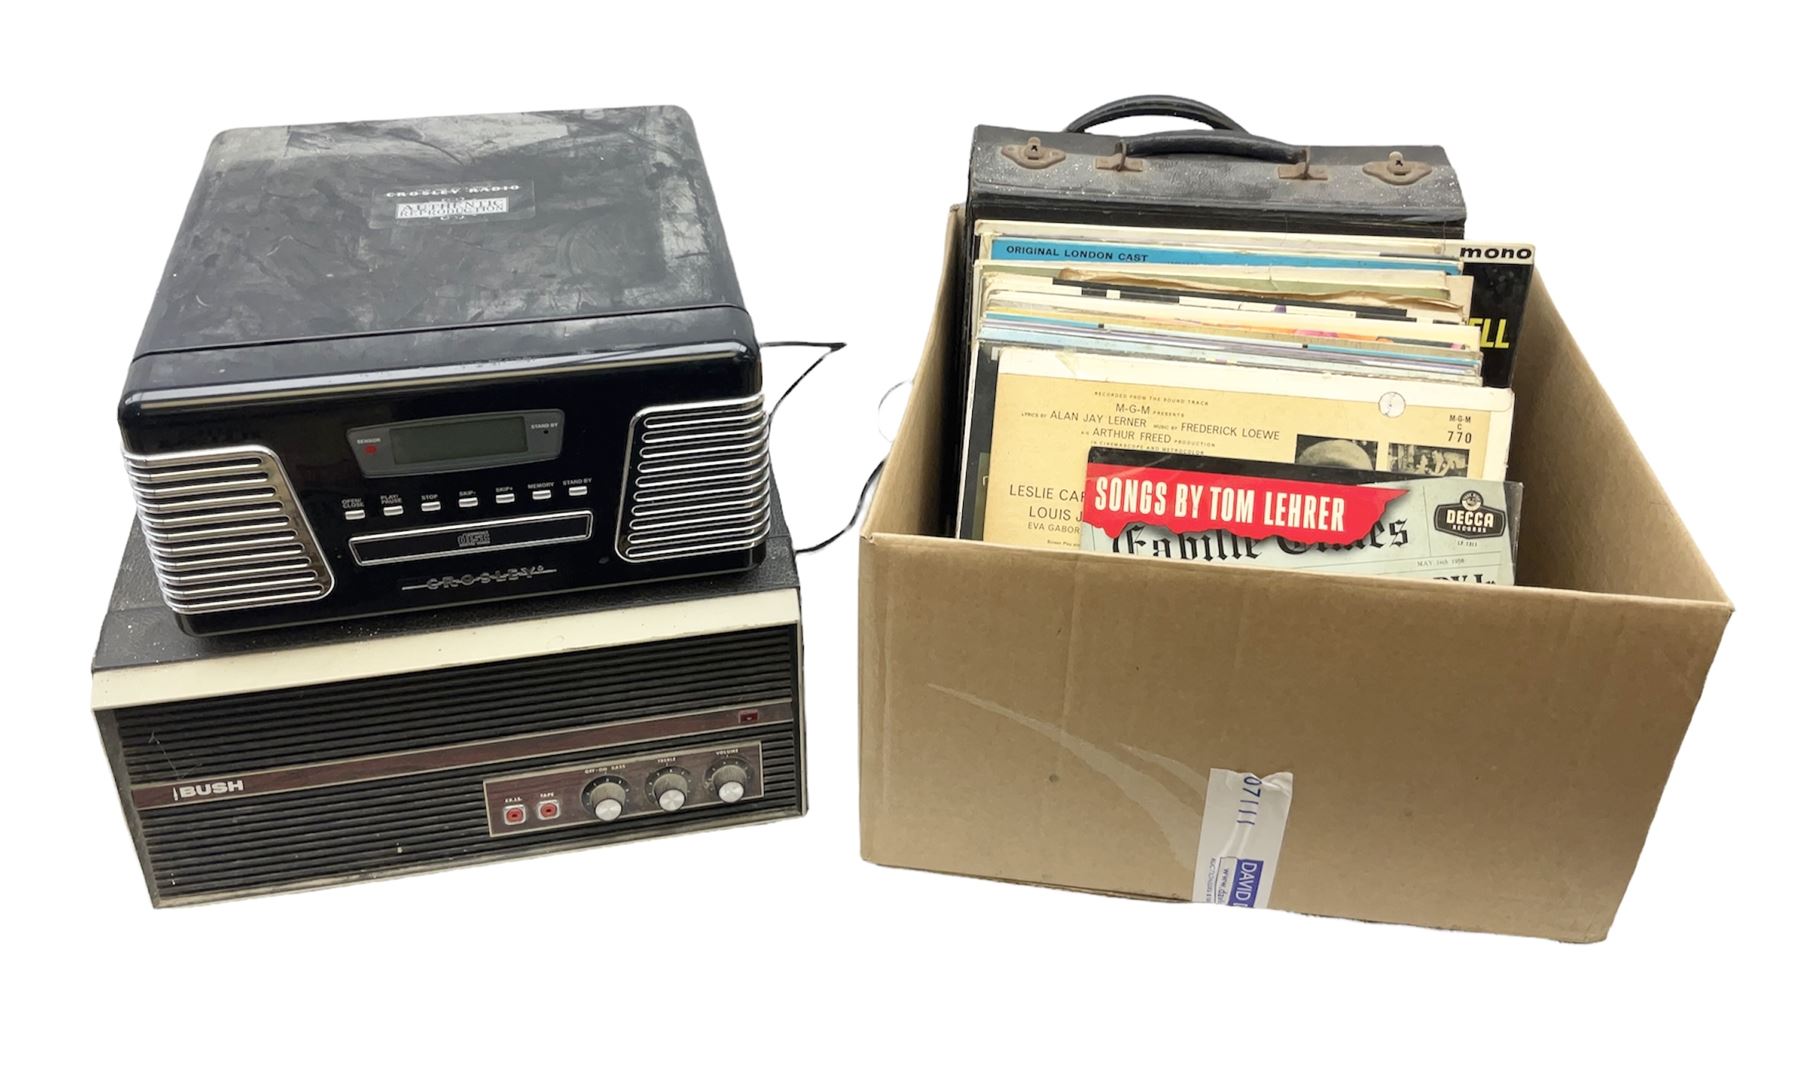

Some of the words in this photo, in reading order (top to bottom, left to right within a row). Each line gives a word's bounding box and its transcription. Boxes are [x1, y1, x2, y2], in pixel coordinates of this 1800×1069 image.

[468, 184, 520, 193] RADIO
[1006, 245, 1059, 256] ORIGINAL
[1064, 249, 1113, 260] LONDON
[1118, 252, 1149, 262] CAST
[1460, 247, 1532, 260] mono
[1115, 403, 1151, 415] M-G-M
[1050, 410, 1079, 421] ALAN
[1083, 413, 1103, 423] JAY
[1108, 415, 1147, 428] LERNER
[1180, 422, 1238, 437] FREDERICK
[1241, 427, 1280, 440] LOEWE
[1457, 423, 1462, 431] C
[1092, 427, 1135, 440] ARTHUR
[1140, 431, 1172, 444] FREED
[1447, 430, 1472, 444] 770
[1009, 484, 1054, 500] LESLIE
[1094, 476, 1168, 516] SONGS
[1174, 483, 1204, 520] BY
[1210, 486, 1255, 524] TOM
[1263, 490, 1345, 532] LEHRER
[1029, 505, 1071, 521] LOUIS
[1446, 509, 1494, 528] DECCA
[1027, 521, 1045, 531] EVA
[1048, 524, 1081, 534] GABOR
[1452, 525, 1487, 533] RECORDS
[179, 780, 244, 799] BUSH
[1235, 861, 1258, 902] DAVID
